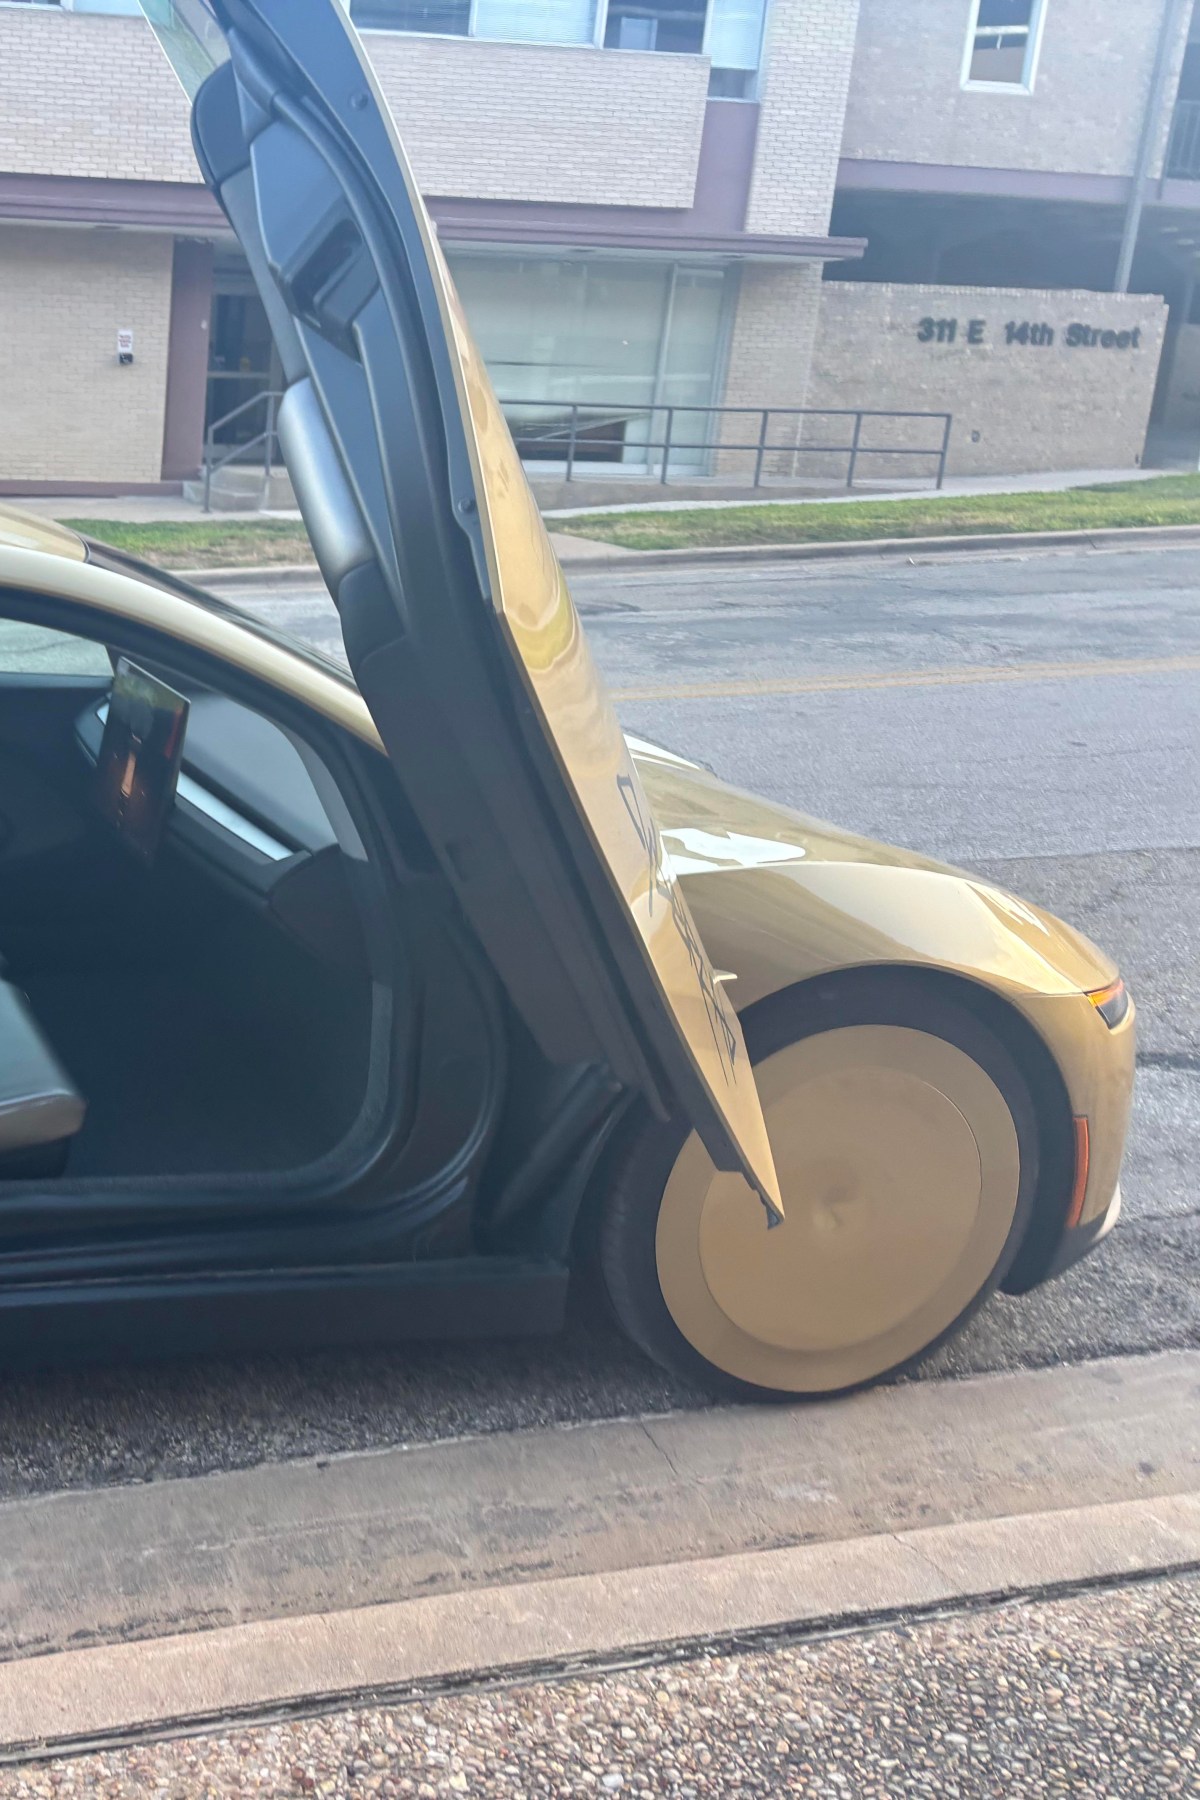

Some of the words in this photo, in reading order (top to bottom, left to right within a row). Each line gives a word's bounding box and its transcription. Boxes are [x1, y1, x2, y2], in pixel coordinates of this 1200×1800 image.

[918, 317, 957, 343] 311
[967, 319, 988, 344] E
[1004, 320, 1054, 346] 14th
[1066, 323, 1141, 348] Street
